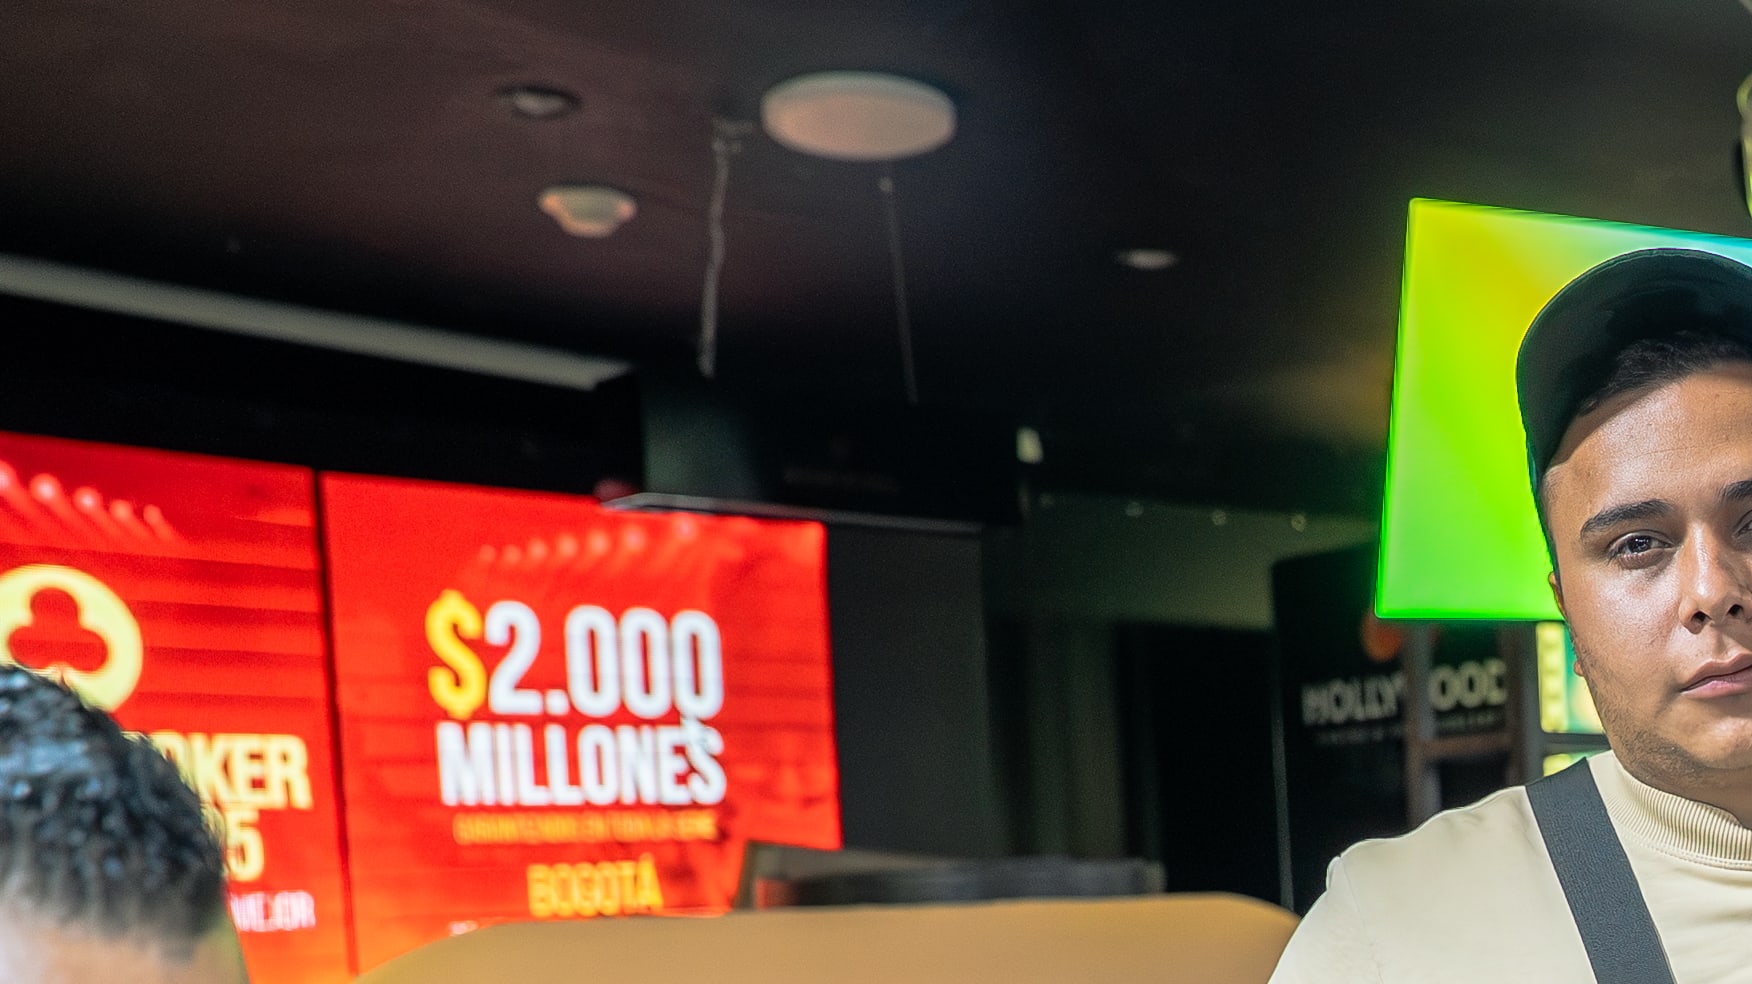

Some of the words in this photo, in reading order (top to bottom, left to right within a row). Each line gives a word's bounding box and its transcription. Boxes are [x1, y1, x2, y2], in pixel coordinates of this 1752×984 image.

[425, 588, 725, 720] $2.000
[436, 721, 727, 808] MILLONES
[527, 852, 664, 918] BOGOTÁ
